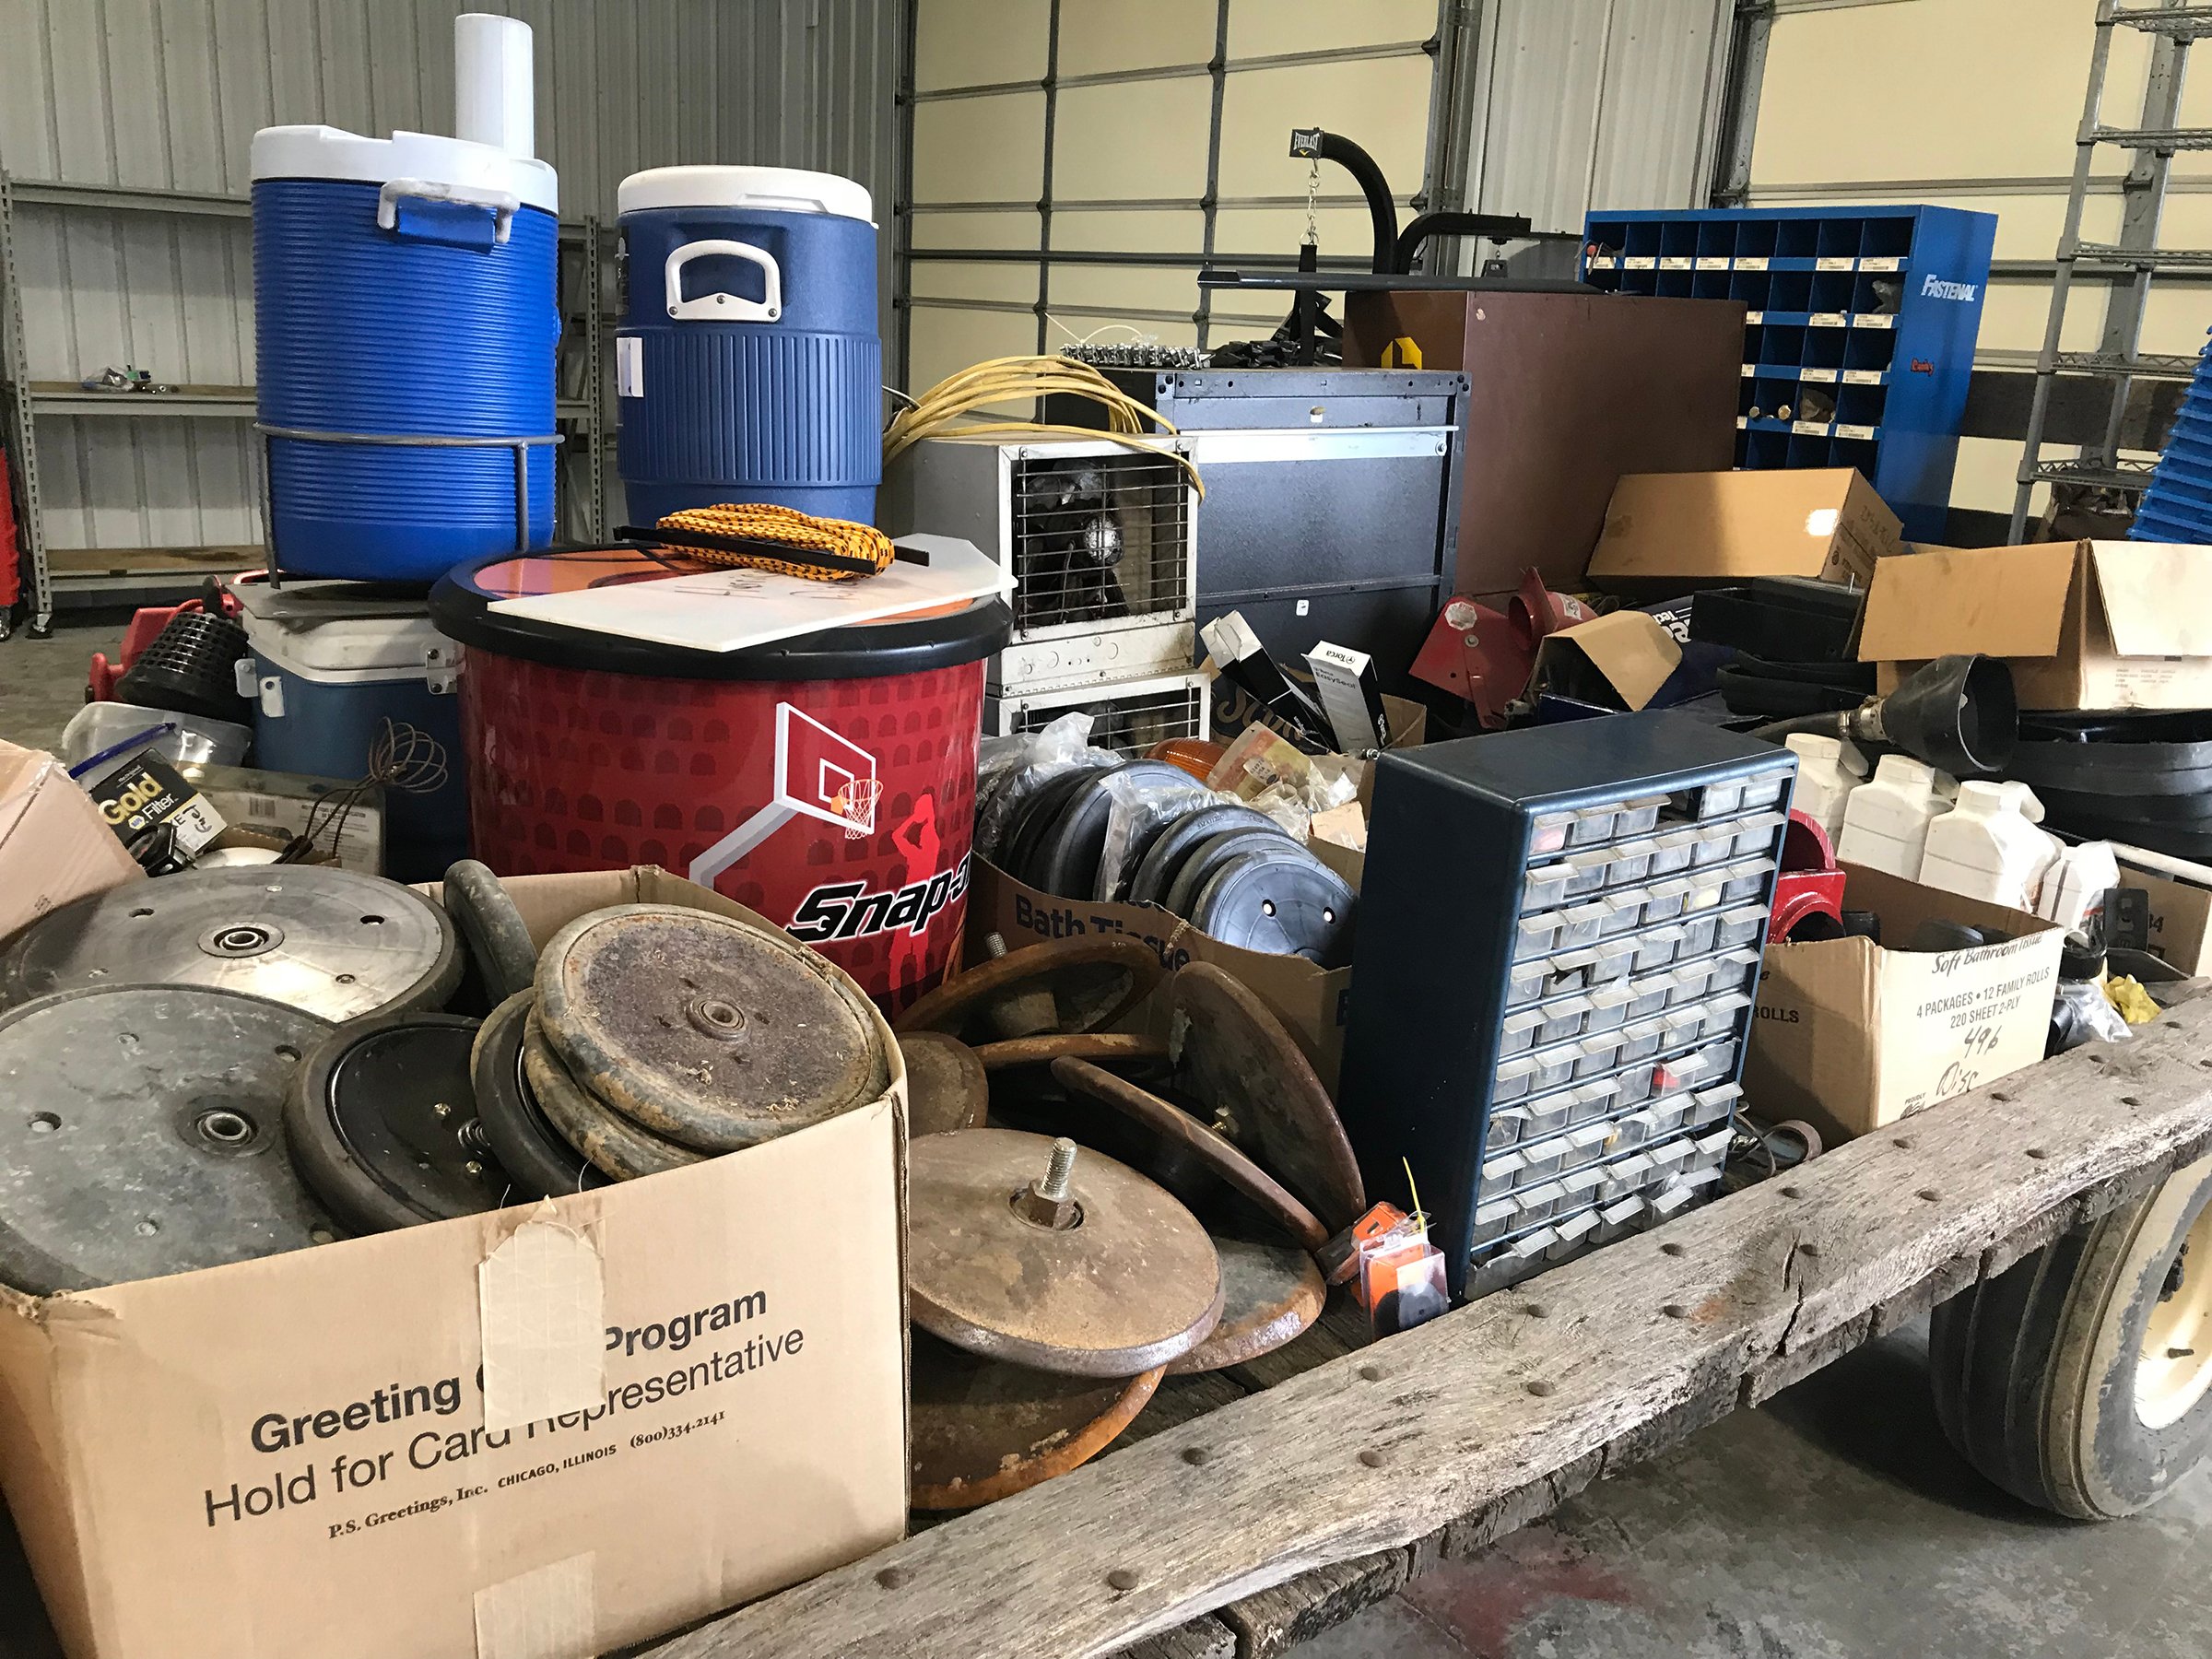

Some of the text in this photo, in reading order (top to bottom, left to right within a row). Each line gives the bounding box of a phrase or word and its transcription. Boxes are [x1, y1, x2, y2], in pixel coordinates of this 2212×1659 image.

[1293, 132, 1320, 151] EVERLAST
[1326, 650, 1347, 663] Torca
[99, 772, 164, 826] Gold
[141, 793, 175, 821] Filter
[1016, 893, 1190, 971] Bath Tiue
[1932, 952, 1961, 977] Soft
[1963, 943, 2018, 966] Bathroom
[1916, 966, 2050, 1018] 4 PACKAGES 12 FAMILY ROLLS
[1950, 995, 2021, 1029] 220 SHEET 2-PLY
[1904, 1091, 1927, 1105] PROUDLY
[251, 1375, 461, 1453] Greeting
[606, 1289, 768, 1357] Program
[205, 1464, 316, 1527] Hold
[331, 1451, 394, 1493] for
[328, 1411, 726, 1539] P.S. Greetings, Inc. CHICAGO, ILLINOIS (800)334.2141
